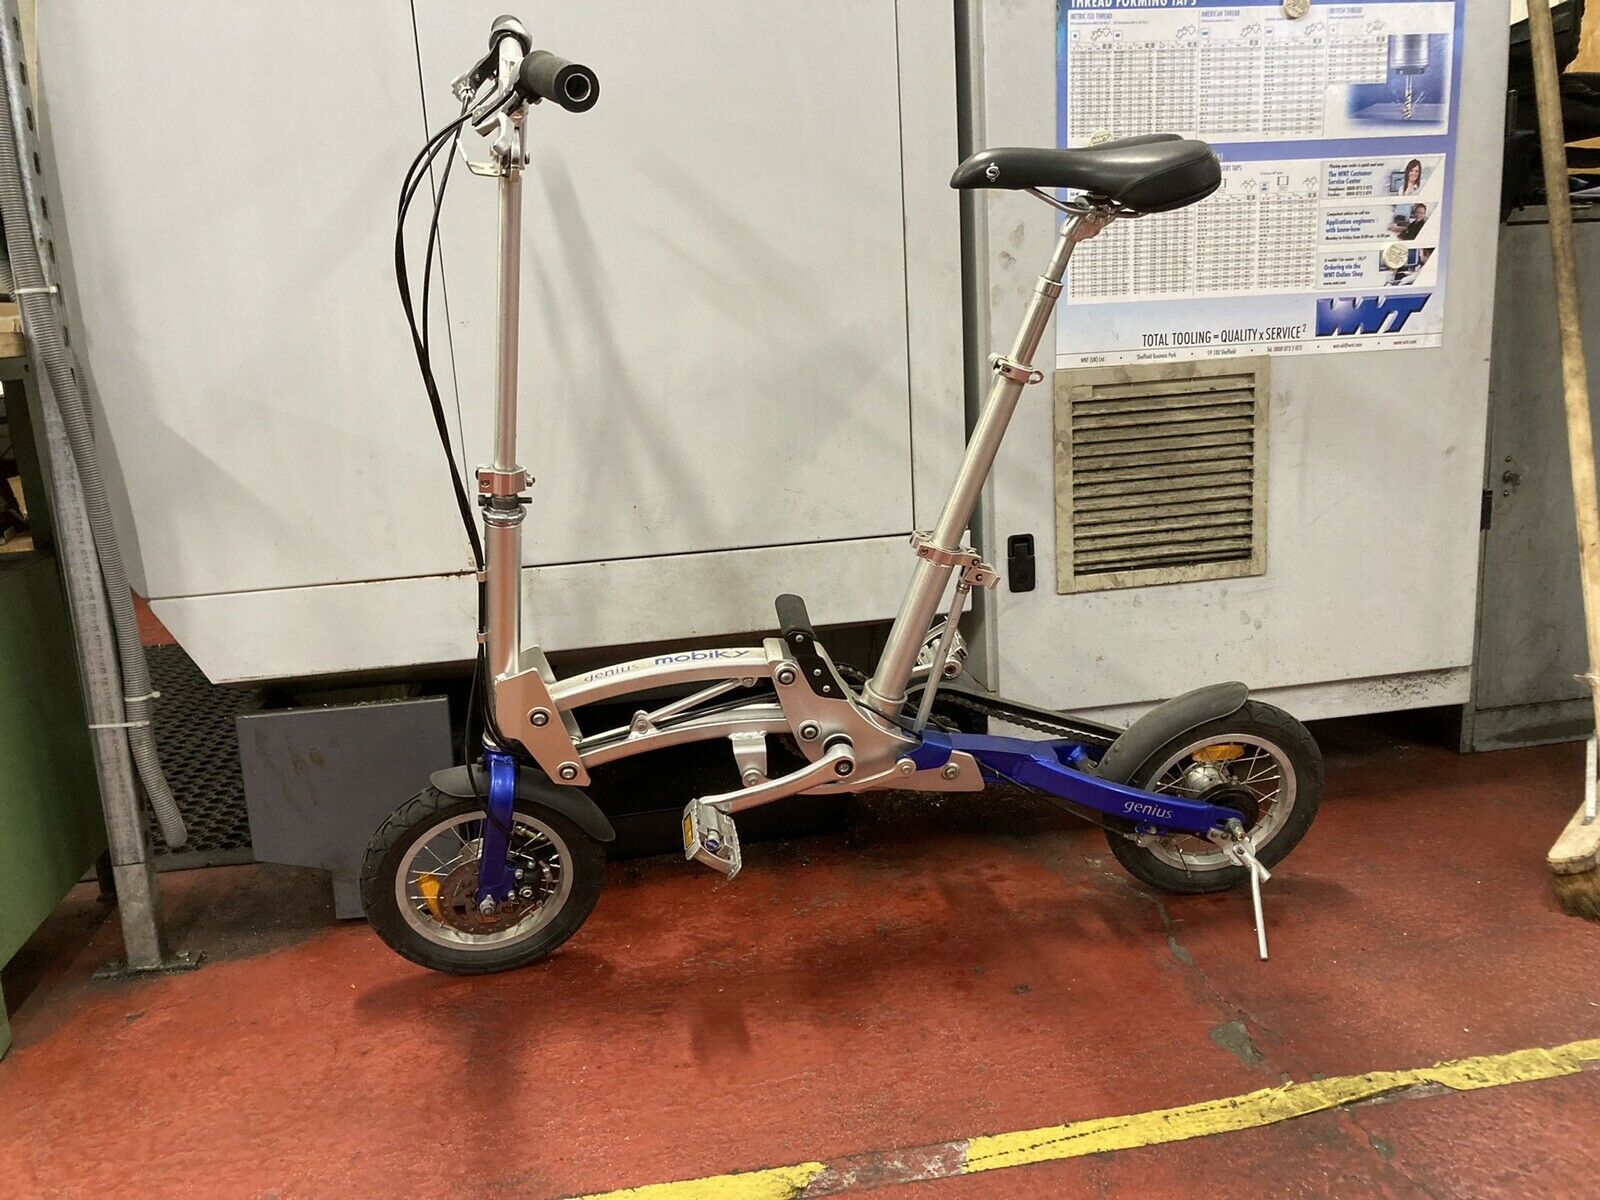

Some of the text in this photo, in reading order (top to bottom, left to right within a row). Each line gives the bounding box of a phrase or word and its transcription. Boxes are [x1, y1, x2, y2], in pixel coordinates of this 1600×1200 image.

[1072, 0, 1112, 8] THREAD
[1316, 292, 1432, 337] WNT
[1142, 333, 1169, 347] TOTAL
[1172, 331, 1211, 345] TOOLING
[1221, 328, 1258, 343] QUALITY
[654, 650, 750, 666] mobiky
[584, 664, 639, 682] genius
[1123, 801, 1174, 819] genius
